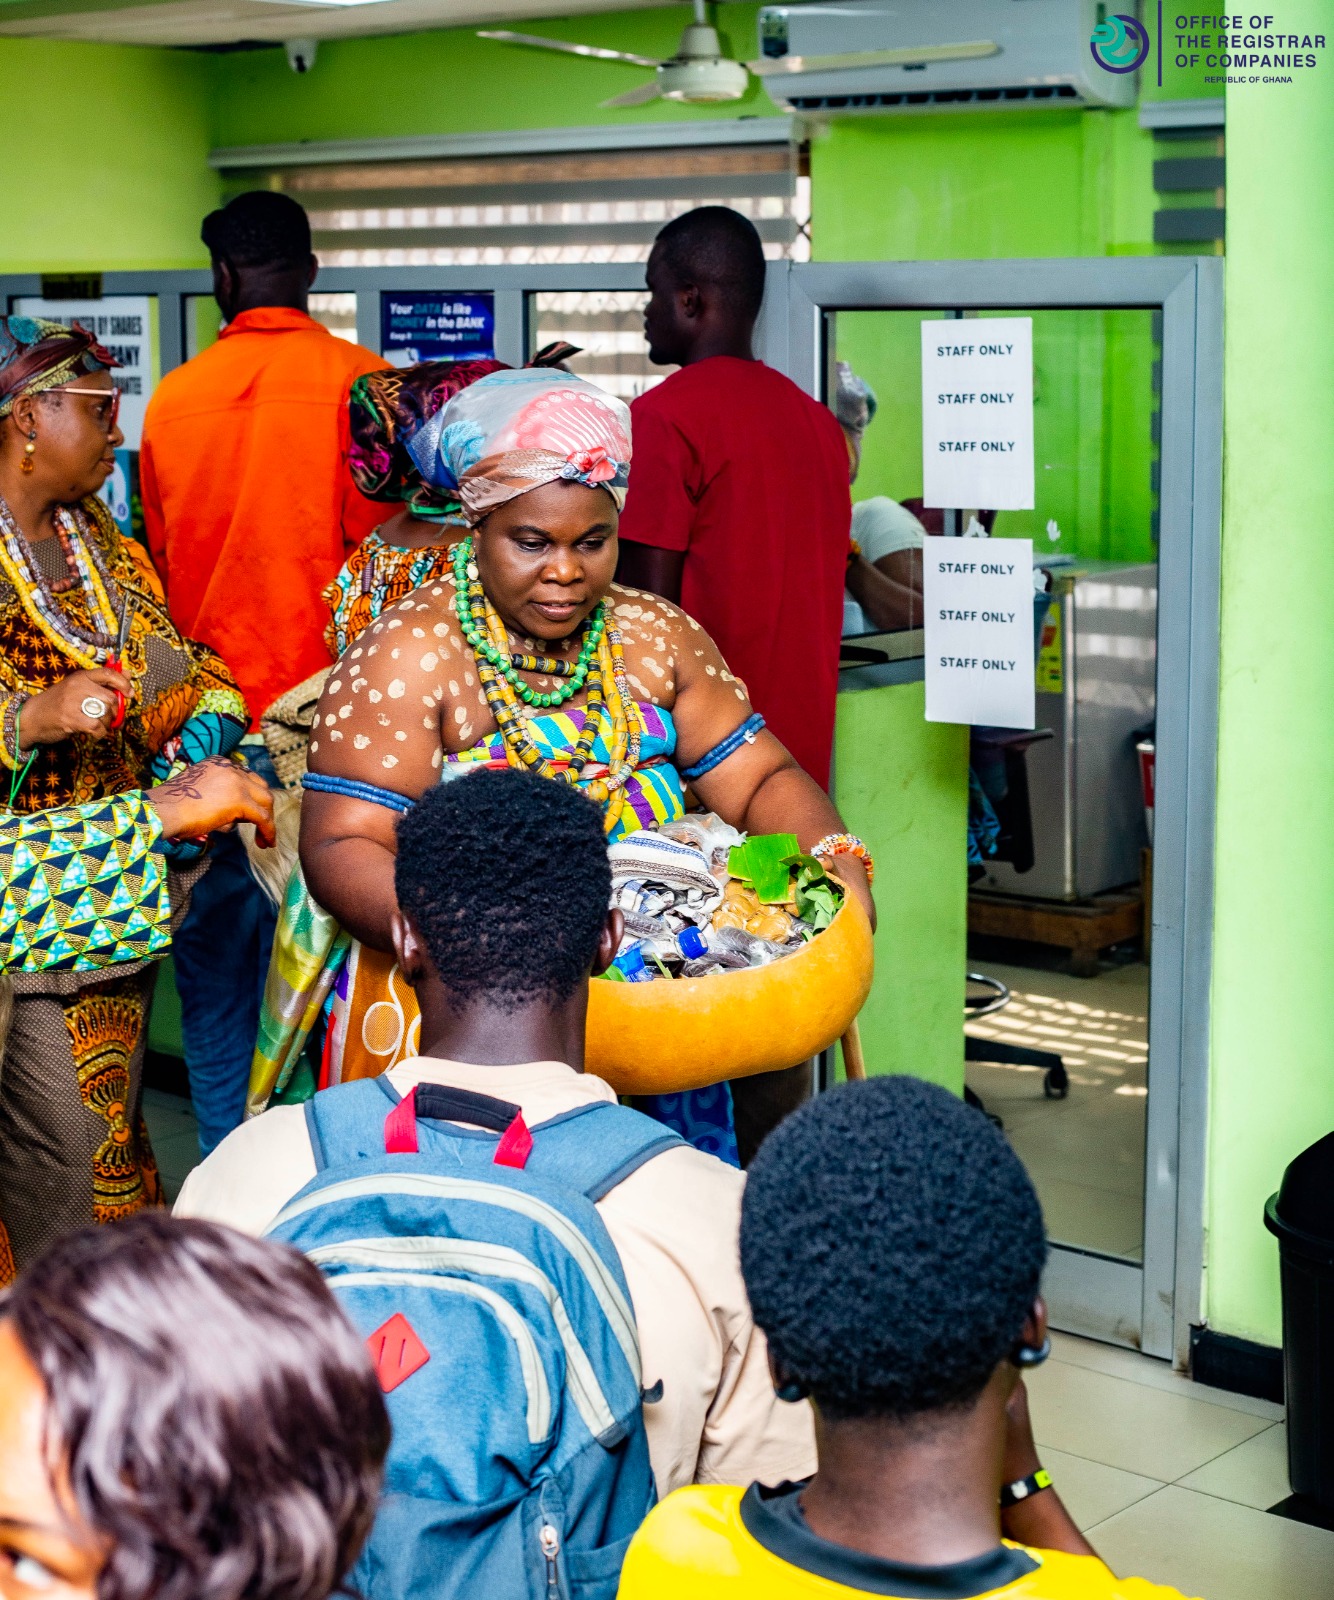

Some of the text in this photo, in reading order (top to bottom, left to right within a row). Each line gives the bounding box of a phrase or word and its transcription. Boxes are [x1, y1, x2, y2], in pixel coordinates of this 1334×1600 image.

[390, 302, 472, 315] Your DATA is like
[110, 316, 142, 335] SHARES
[390, 316, 485, 328] MONEY in the BANK
[937, 344, 1013, 357] STAFF ONLY
[937, 393, 1014, 405] STAFF ONLY
[938, 441, 1015, 452] STAFF ONLY
[938, 562, 1015, 575] STAFF ONLY
[939, 609, 1015, 623] STAFF ONLY
[940, 656, 1016, 671] STAFF ONLY
